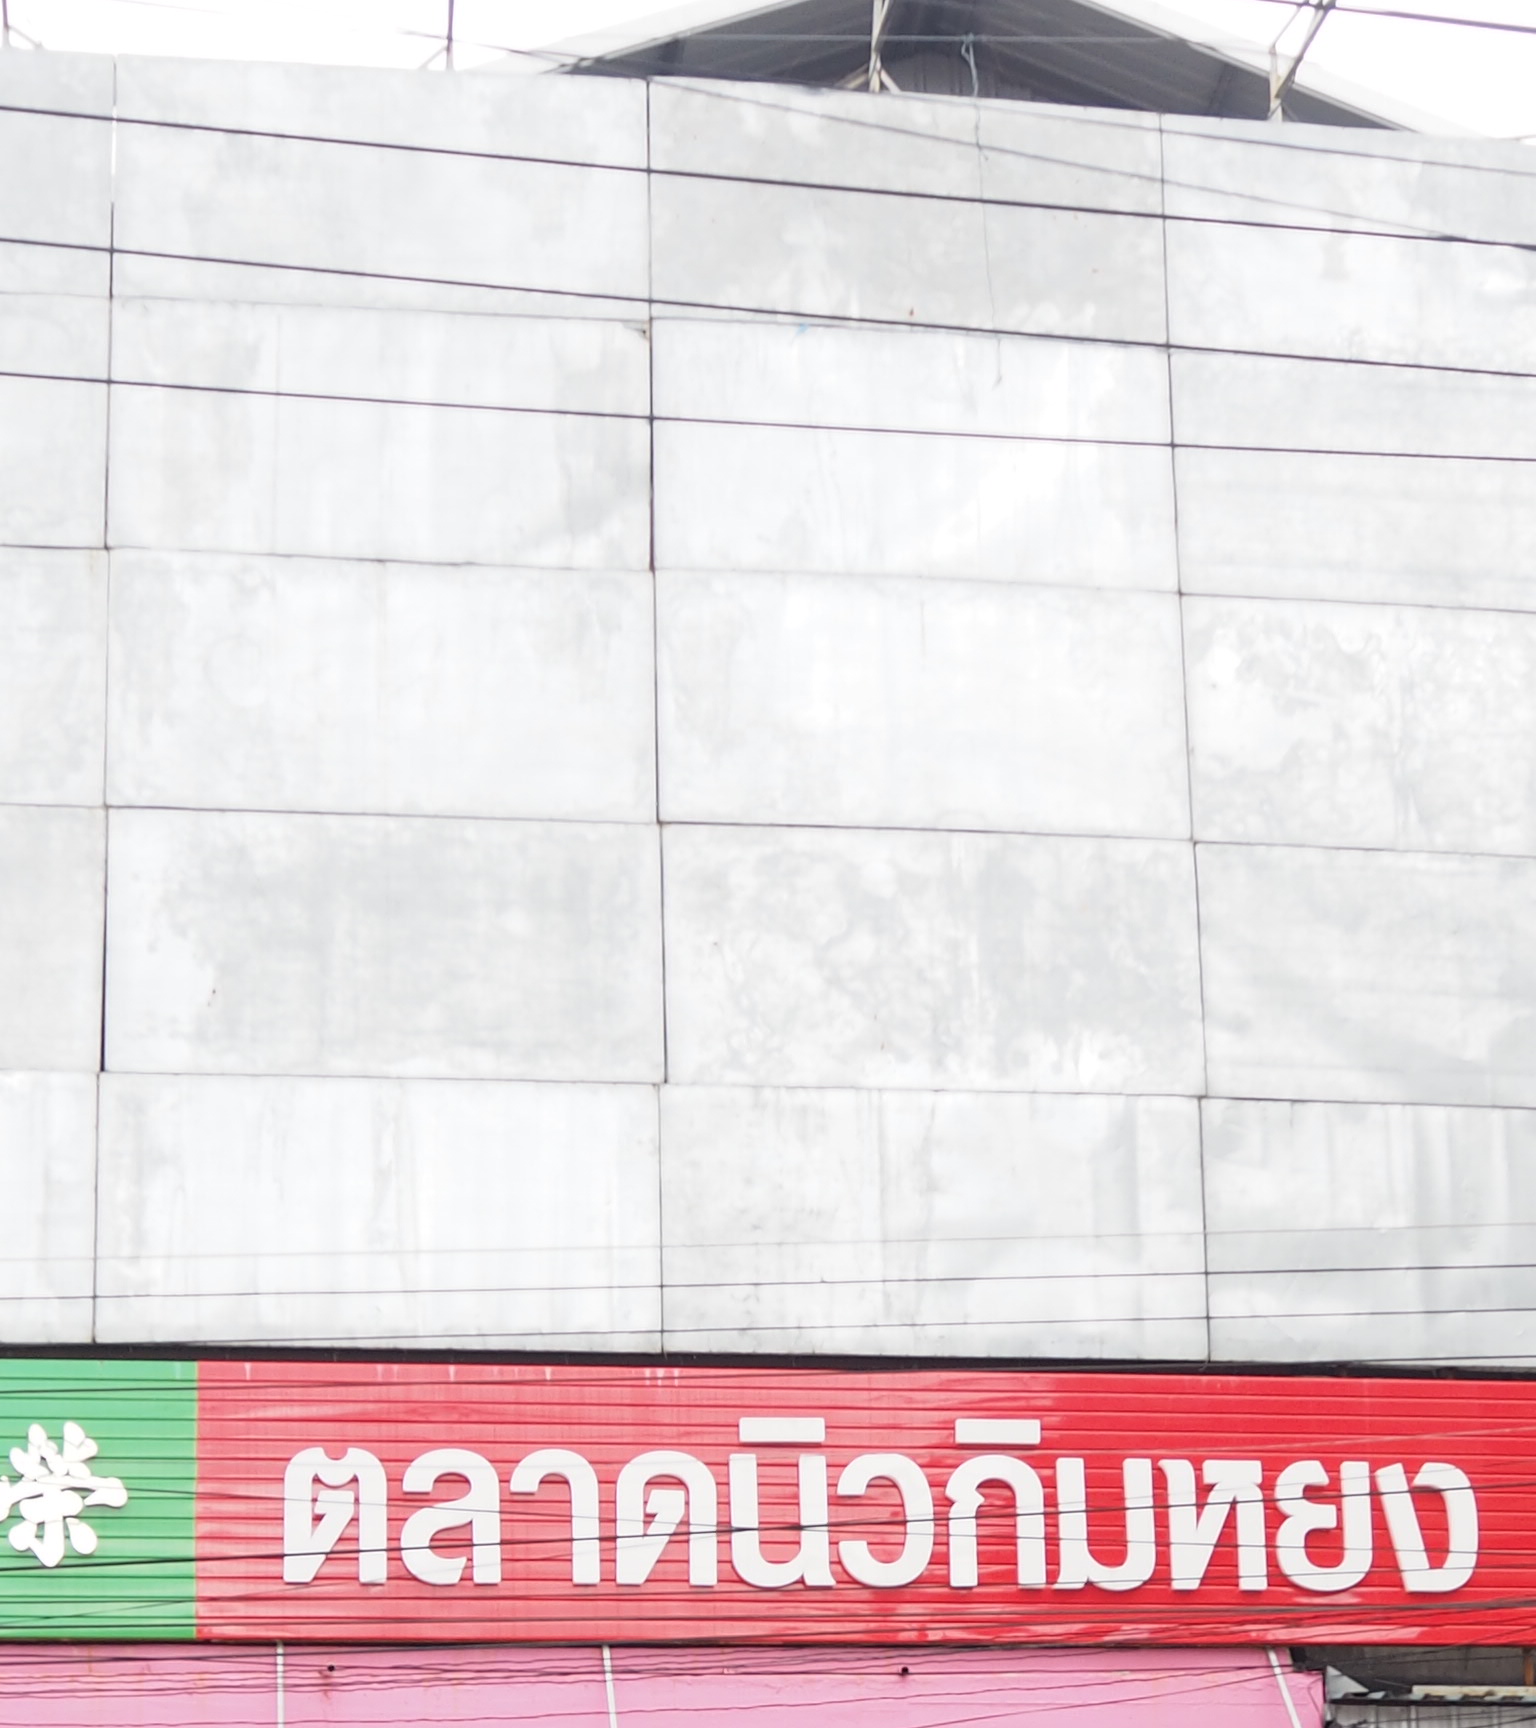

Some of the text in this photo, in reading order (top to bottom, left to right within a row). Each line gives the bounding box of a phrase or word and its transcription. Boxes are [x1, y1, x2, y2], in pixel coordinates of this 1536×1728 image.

[281, 1416, 1478, 1592] ตลาดนิวกิมหยง
